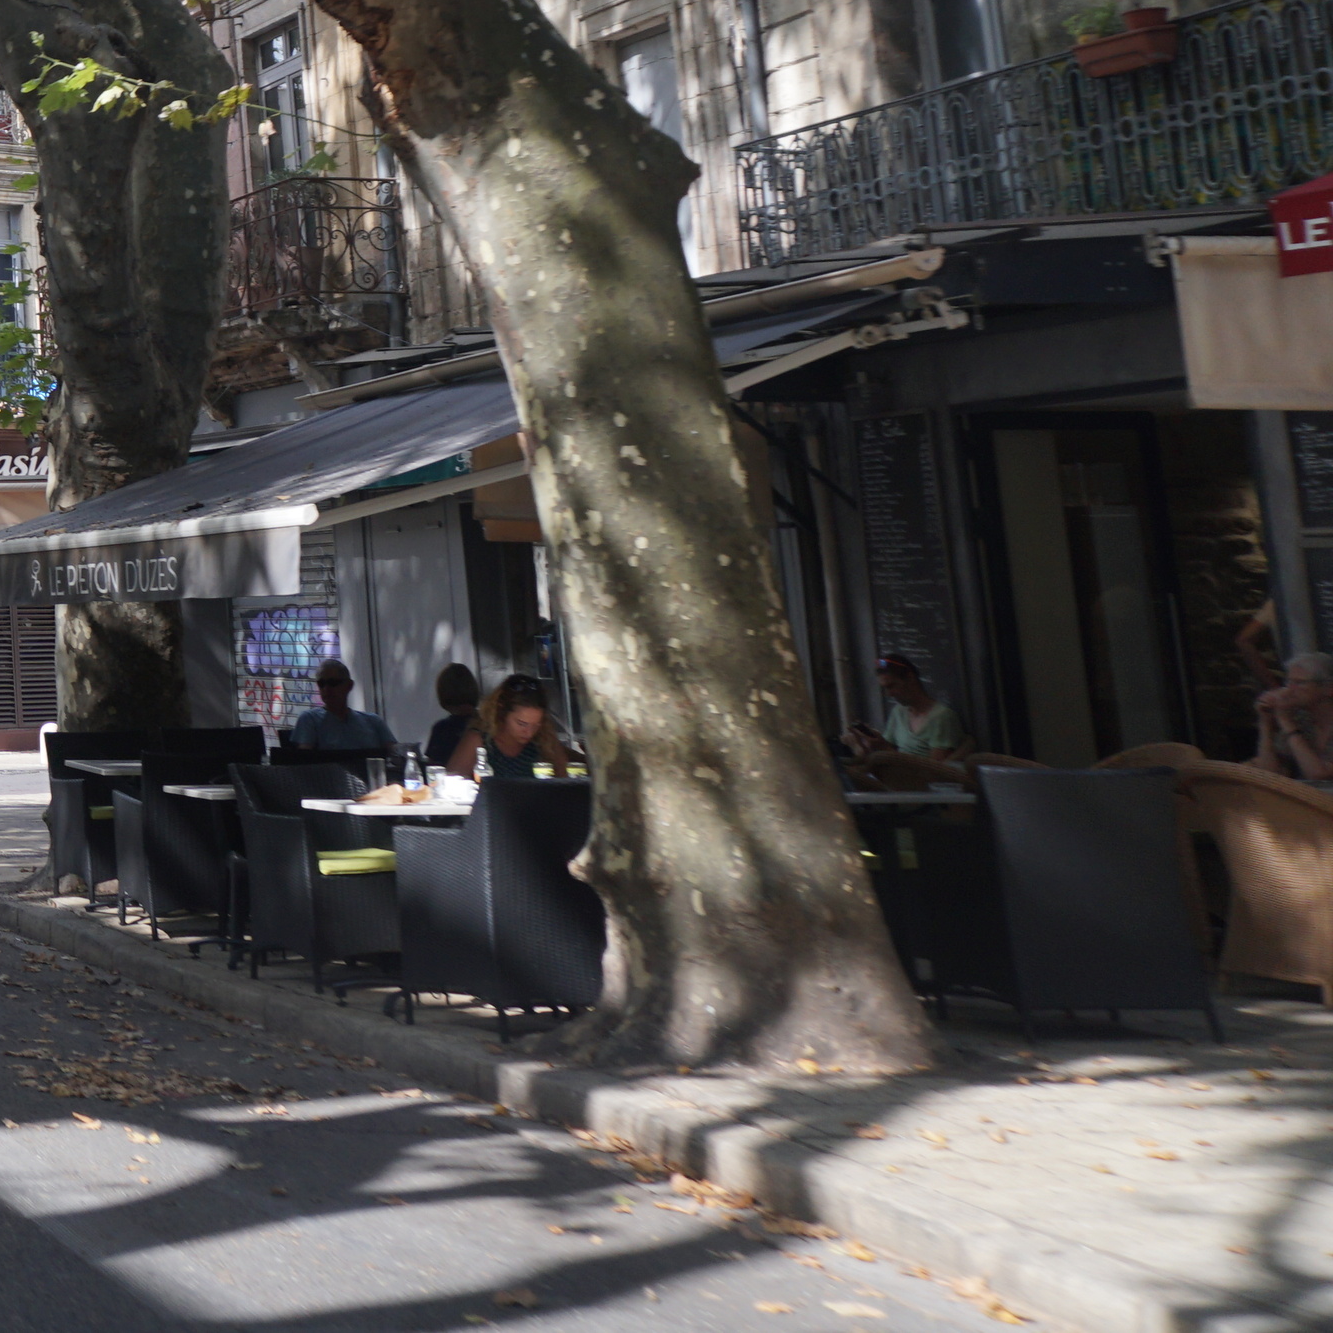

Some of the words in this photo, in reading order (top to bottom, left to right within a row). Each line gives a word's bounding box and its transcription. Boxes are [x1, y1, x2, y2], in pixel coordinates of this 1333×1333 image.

[48, 566, 65, 597] LE
[67, 556, 119, 595] PIÉTON
[125, 549, 178, 593] D'UZÈS
